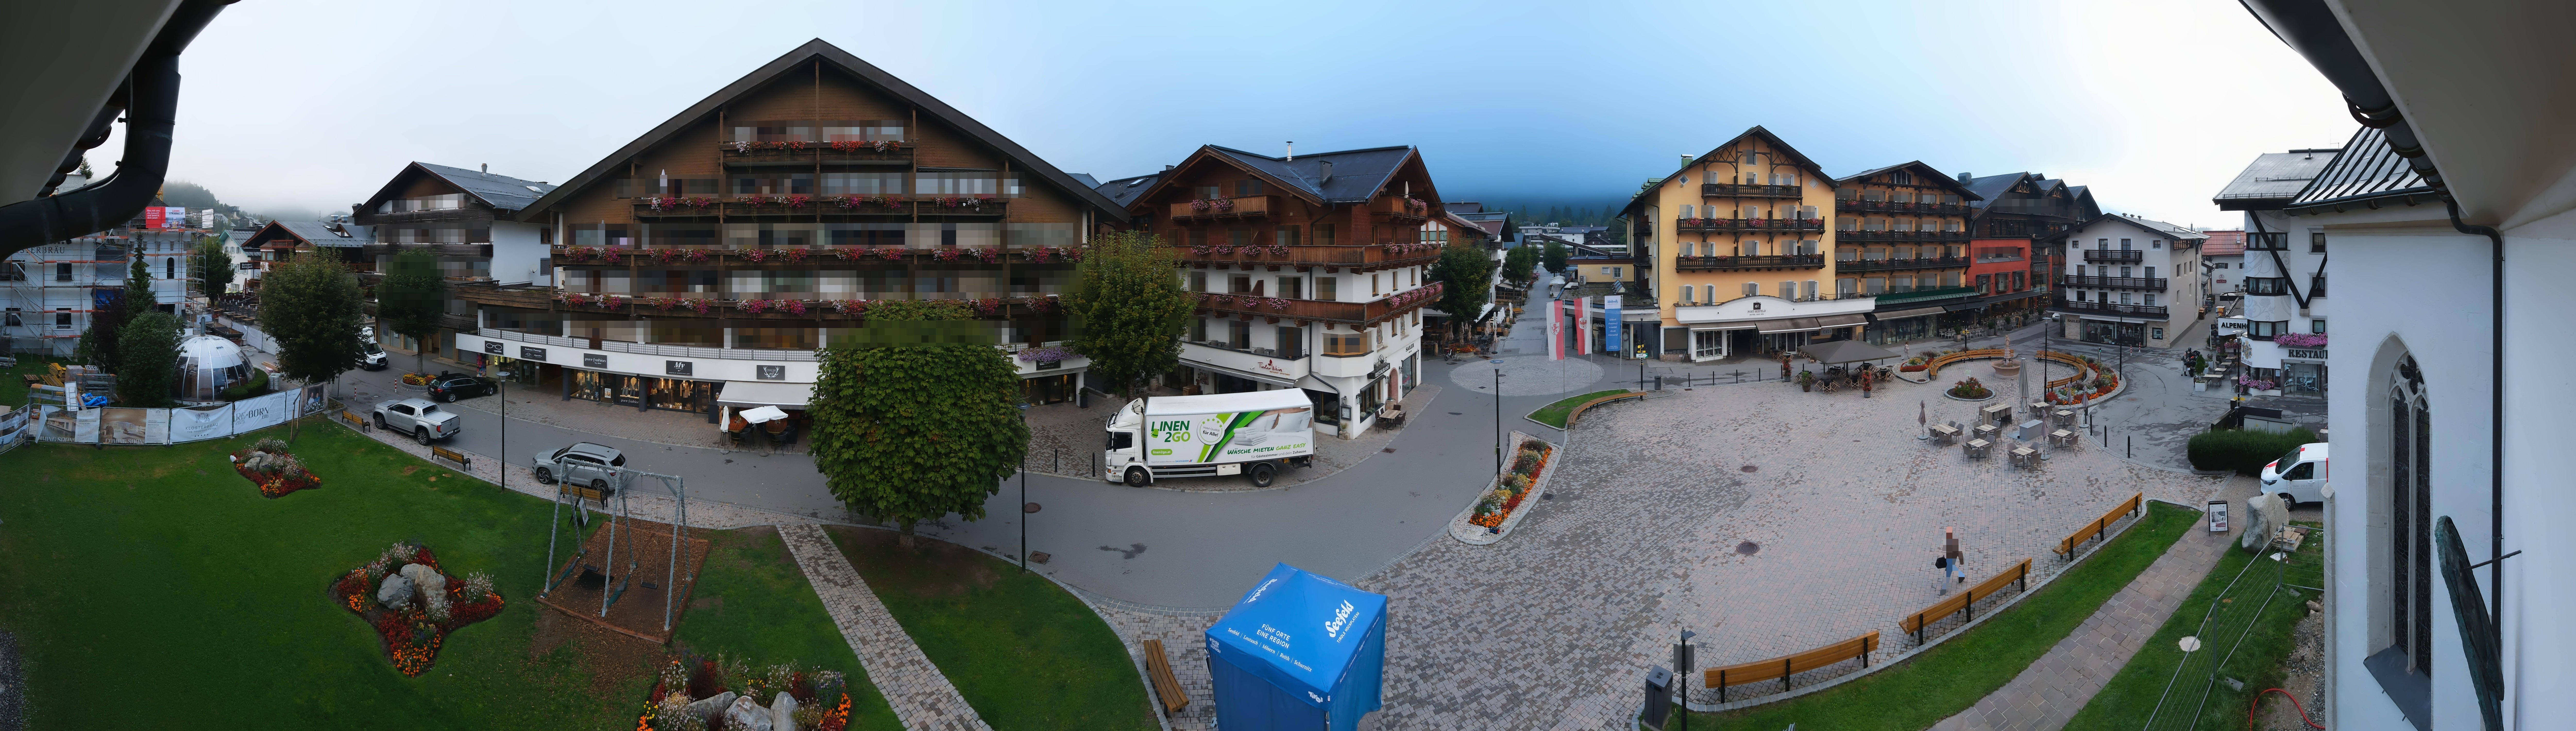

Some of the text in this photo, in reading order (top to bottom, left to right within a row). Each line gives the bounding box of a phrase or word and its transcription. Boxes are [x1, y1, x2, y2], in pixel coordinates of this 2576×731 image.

[1406, 343, 1414, 352] SAILER
[2242, 356, 2252, 366] Kaltschmid
[1375, 364, 1389, 378] RESTAURANT
[1151, 421, 1190, 431] LINEN
[1164, 431, 1190, 442] 2GO
[1248, 579, 1277, 603] Seefeld
[1325, 599, 1354, 638] Seefeld
[1262, 624, 1290, 641] FÜNF ORTE
[1336, 611, 1360, 643] TIROLS HOCHPLATEAU
[1209, 637, 1219, 645] #tirols
[1257, 629, 1289, 649] EINE REGION
[1210, 644, 1221, 653] plateau
[1228, 627, 1312, 672] Seefeld Leutasch Mösern Reith Scharnitz
[1308, 691, 1323, 703] Tirol
